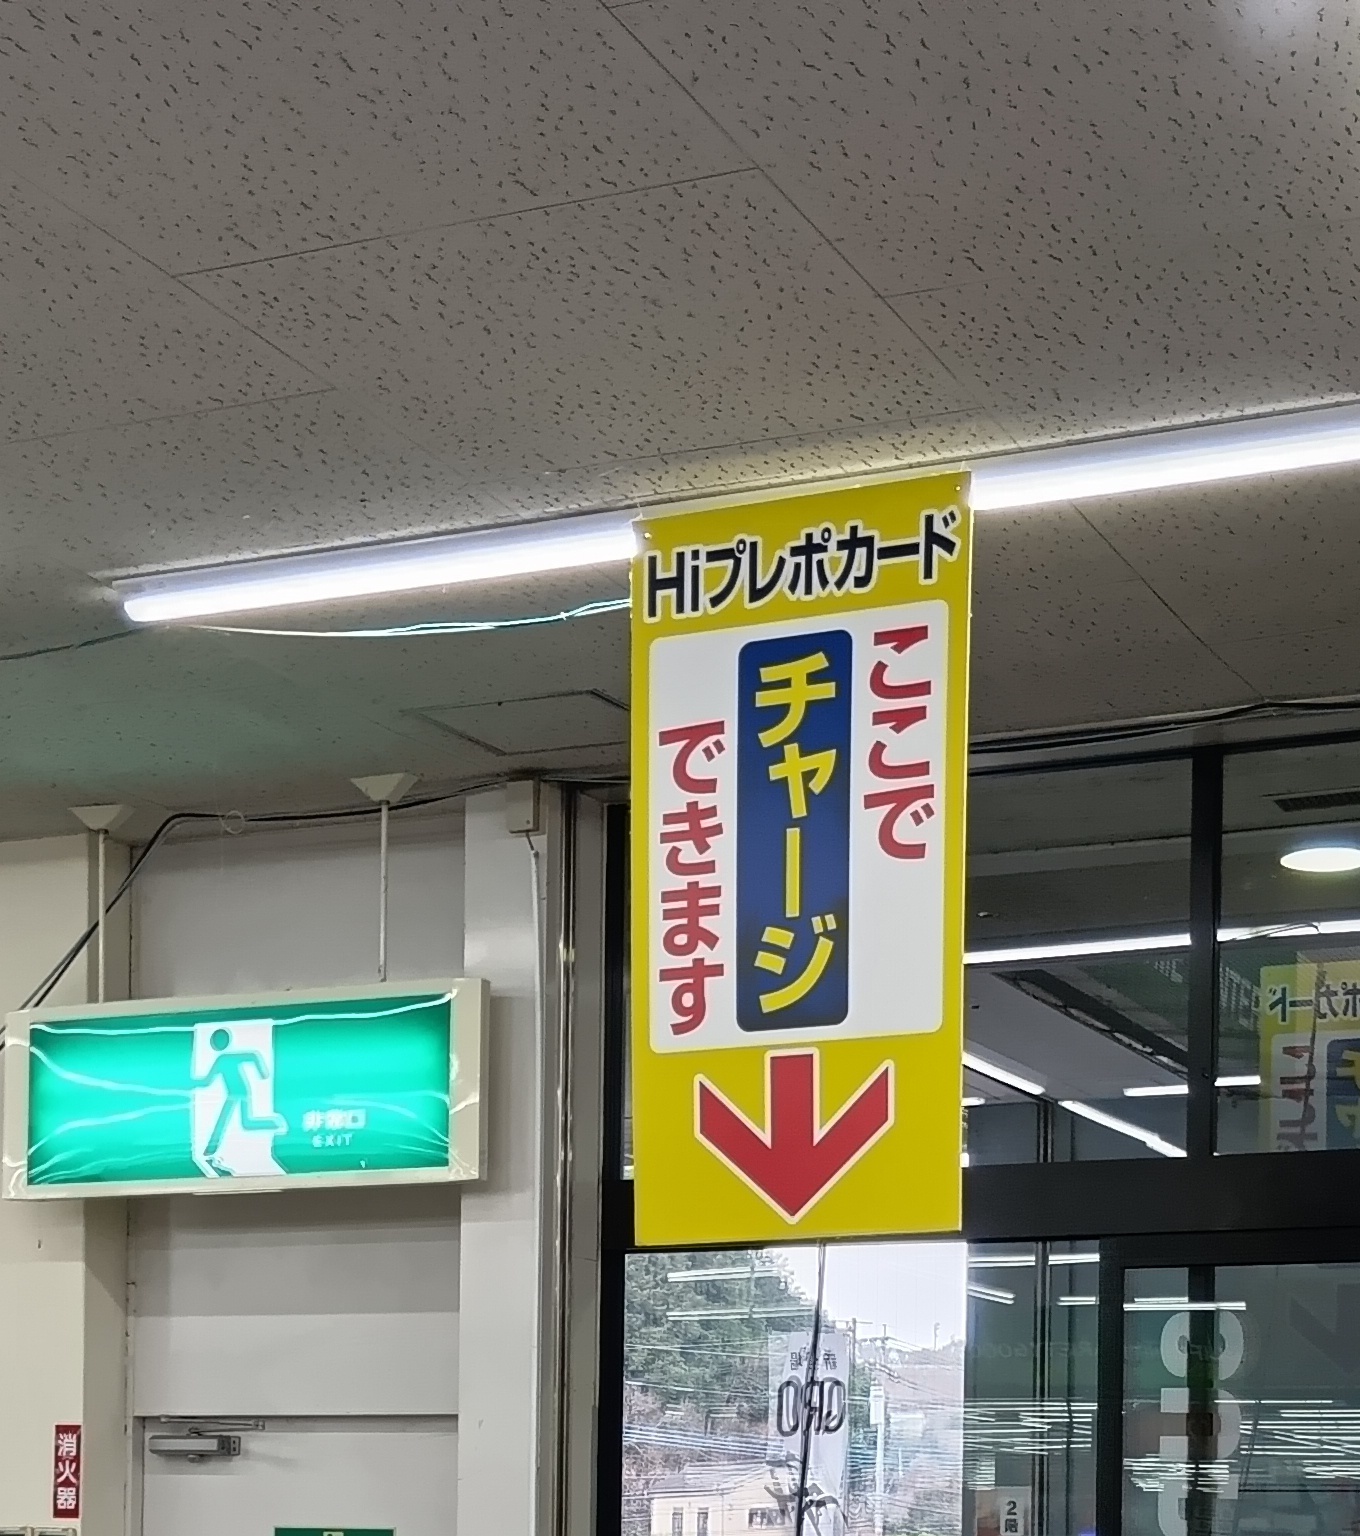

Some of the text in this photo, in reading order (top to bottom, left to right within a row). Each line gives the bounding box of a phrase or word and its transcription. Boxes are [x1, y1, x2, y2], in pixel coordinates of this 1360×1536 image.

[645, 508, 959, 621] Hiプレポカード
[862, 625, 937, 861] ここで
[657, 720, 727, 1036] できます
[755, 651, 837, 1015] チャージ
[311, 1132, 353, 1148] EXIT
[56, 1431, 78, 1511] 消火器
